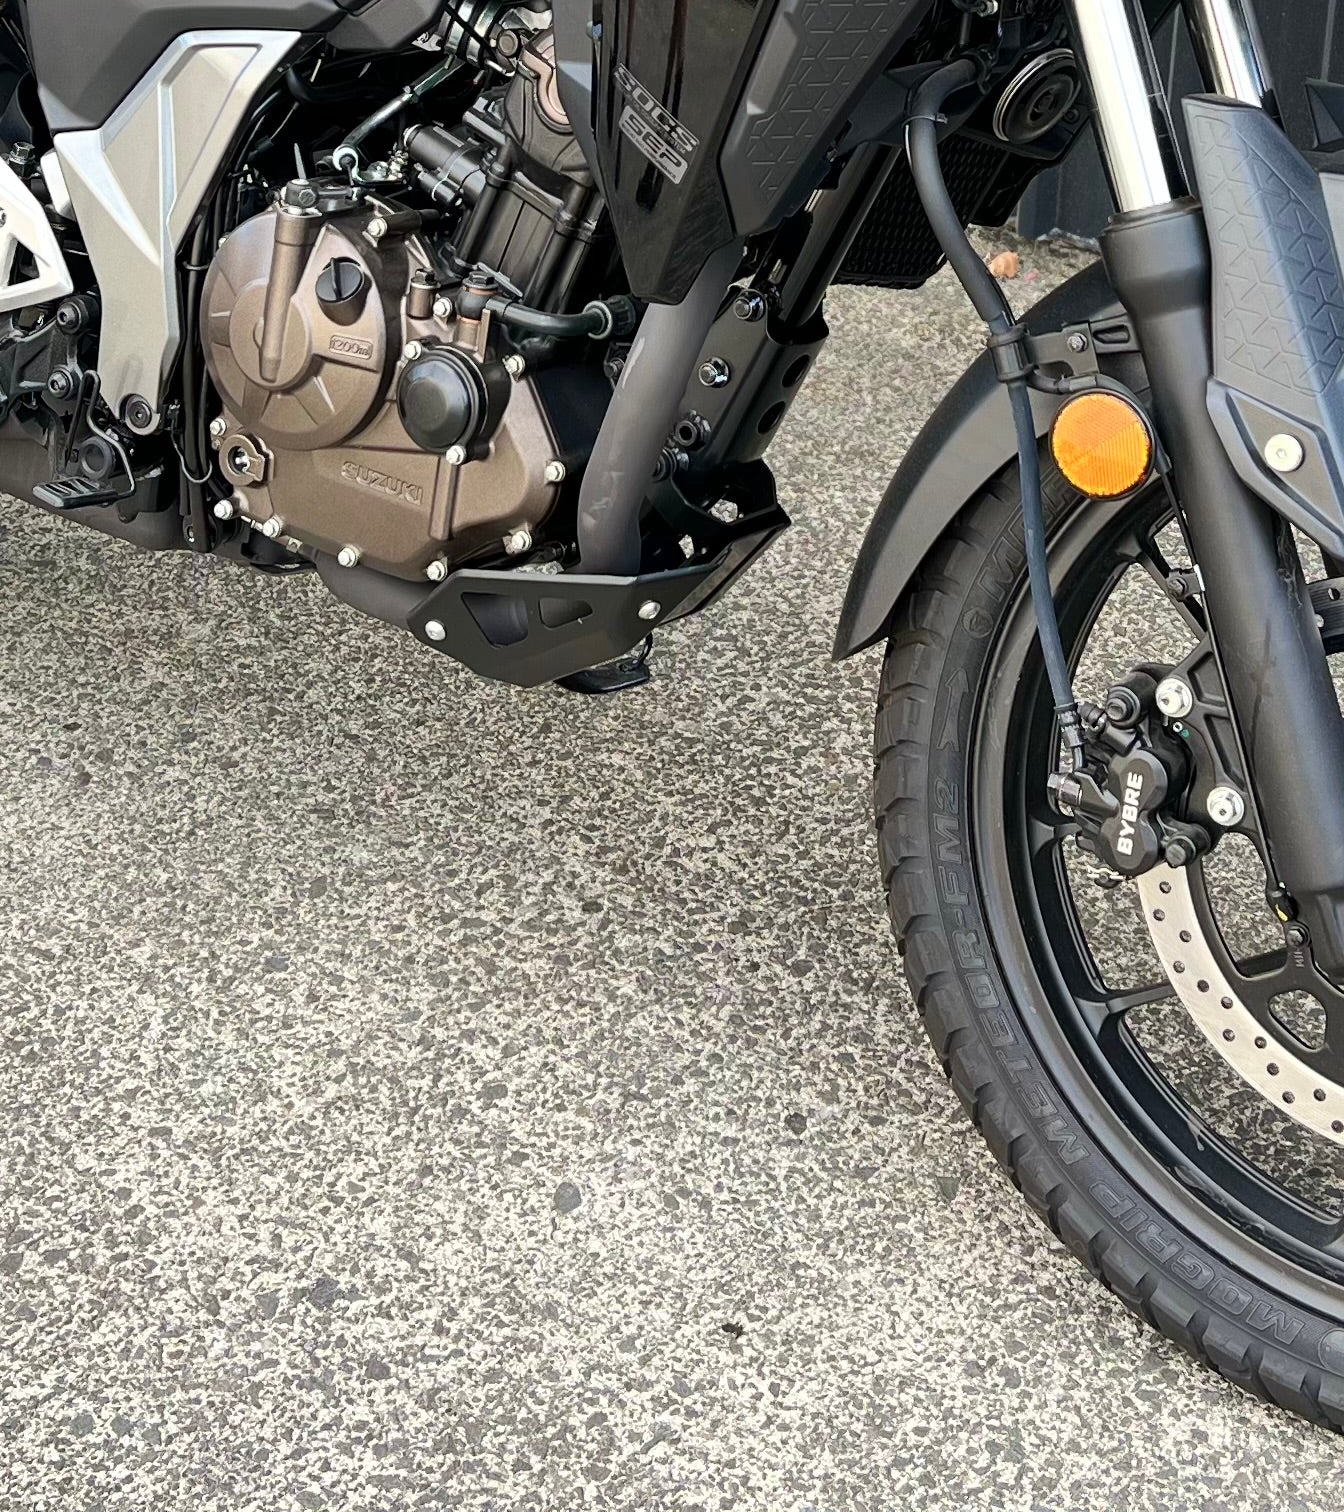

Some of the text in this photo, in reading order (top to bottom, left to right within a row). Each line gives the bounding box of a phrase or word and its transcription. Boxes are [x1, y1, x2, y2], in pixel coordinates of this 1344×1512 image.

[614, 67, 698, 153] SOCS
[623, 113, 682, 168] SEP
[340, 459, 424, 506] SUZUKI
[1115, 770, 1144, 857] BYBRE
[1088, 1179, 1306, 1346] MOGRIP
